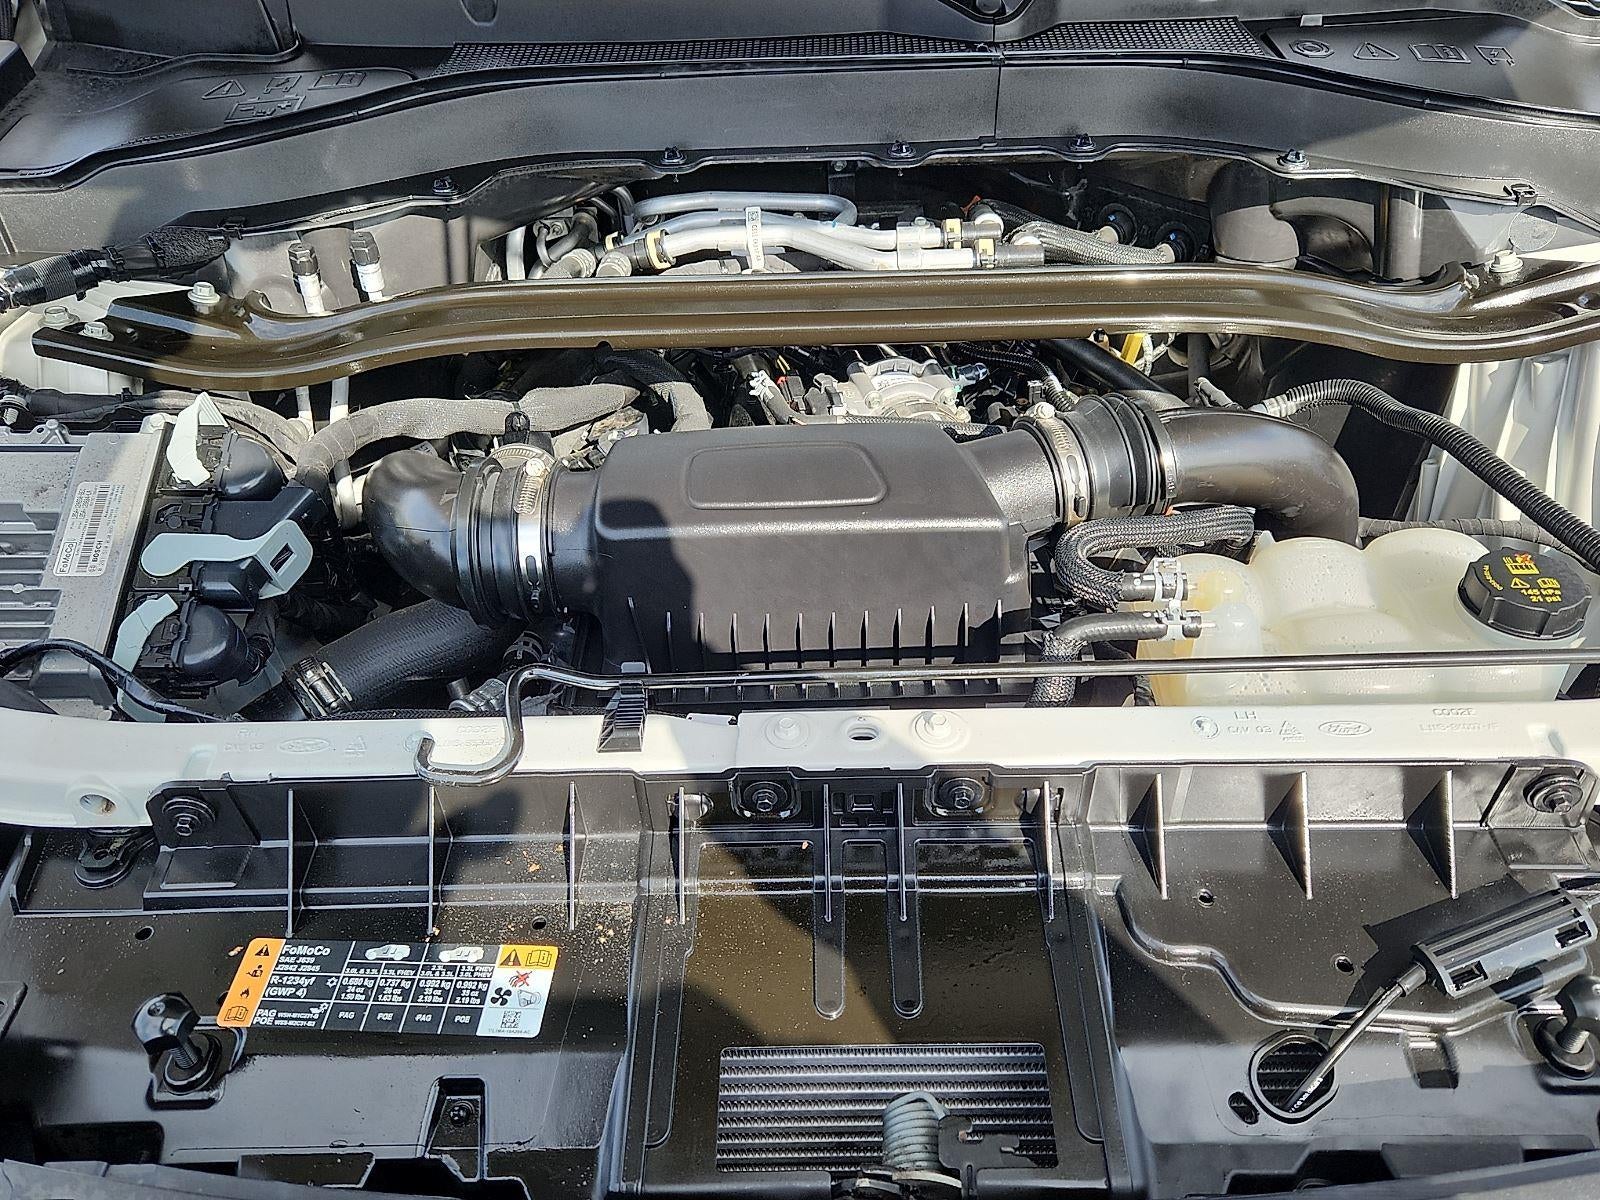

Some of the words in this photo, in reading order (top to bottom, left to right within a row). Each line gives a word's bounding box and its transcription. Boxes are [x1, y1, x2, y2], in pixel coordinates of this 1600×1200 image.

[92, 540, 103, 562] BOSCH
[60, 543, 74, 573] FoMoCo
[1520, 588, 1540, 596] 145
[281, 944, 331, 956] FoMoCo
[296, 956, 316, 964] J639
[270, 976, 317, 986] R-1234yf
[363, 978, 375, 988] kg
[379, 979, 401, 987] 0.737
[400, 979, 412, 990] kg
[419, 979, 441, 988] 0.992
[441, 980, 452, 991] kg
[456, 981, 478, 990] 0.992
[478, 982, 489, 992] kg
[265, 987, 296, 998] (GWP
[296, 988, 307, 998] 4)
[417, 995, 433, 1003] 2.19
[470, 997, 481, 1005] lbs
[256, 1008, 278, 1017] PAG
[338, 1011, 355, 1019] PAG
[376, 1012, 394, 1021] POE
[253, 1017, 275, 1025] POE
[415, 1013, 432, 1022] PAG
[454, 1014, 471, 1023] POE
